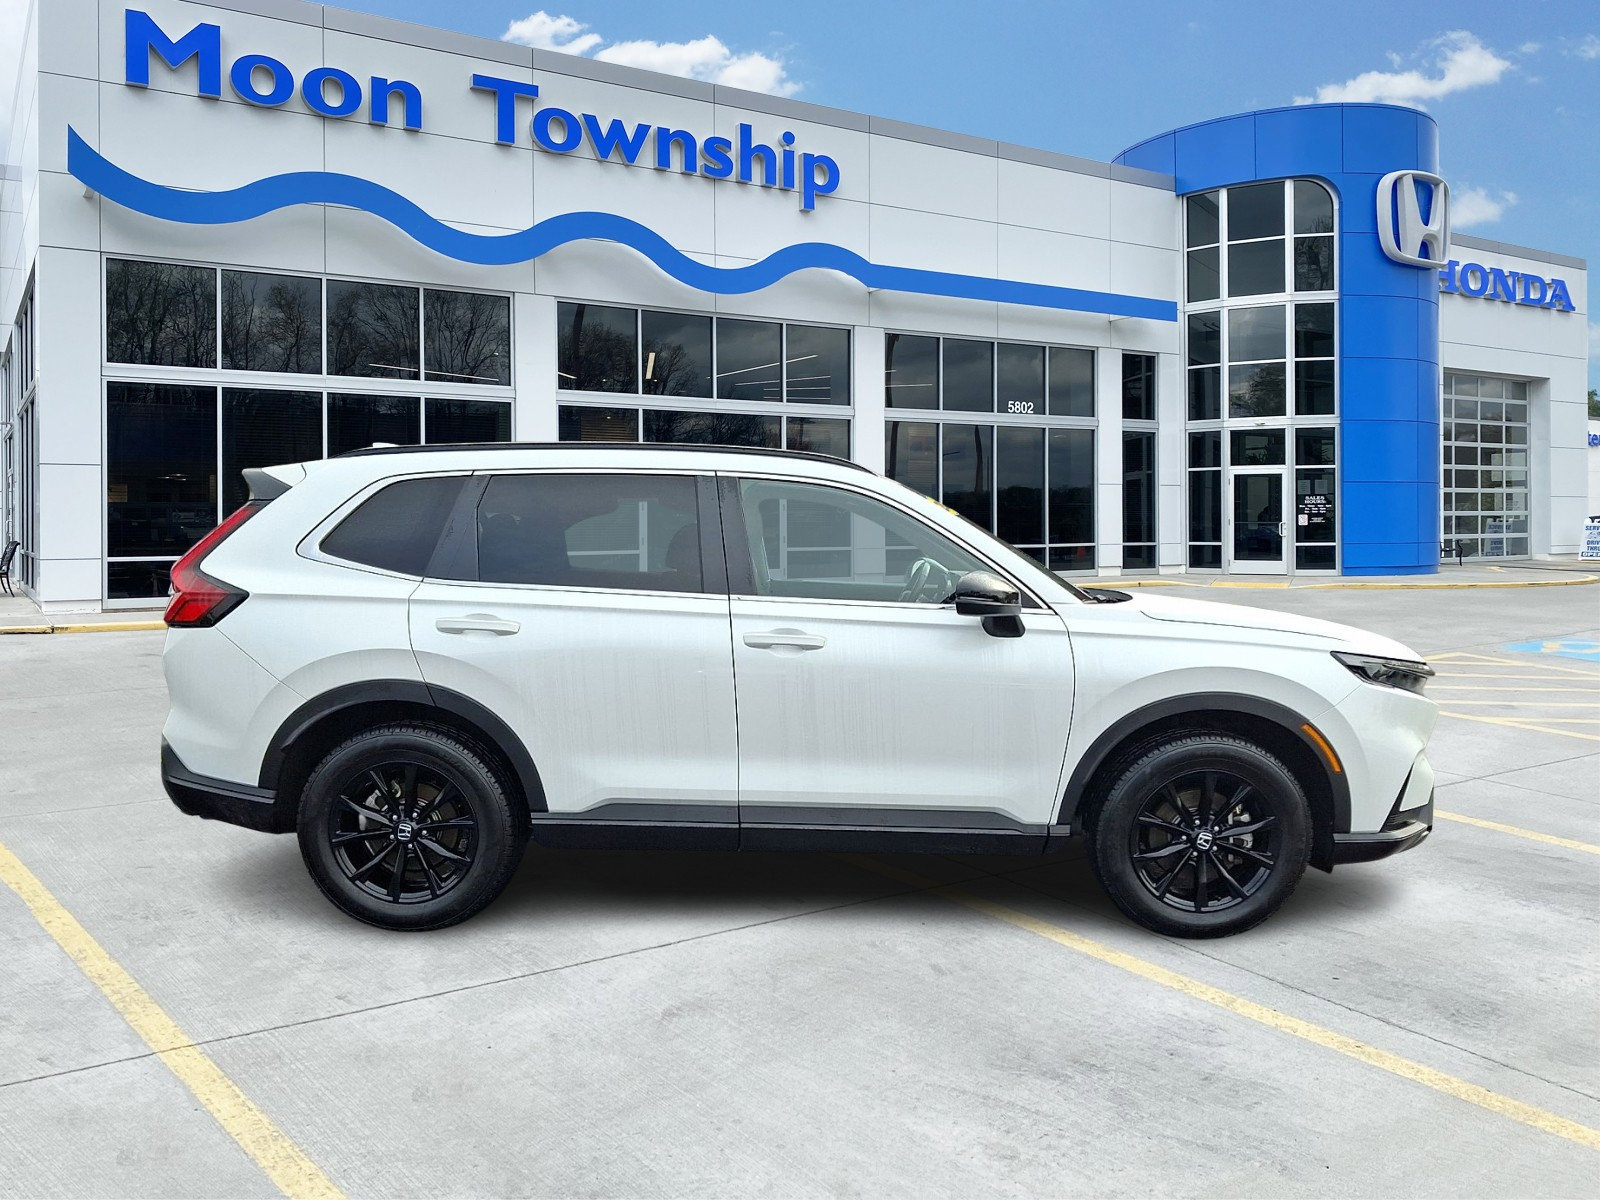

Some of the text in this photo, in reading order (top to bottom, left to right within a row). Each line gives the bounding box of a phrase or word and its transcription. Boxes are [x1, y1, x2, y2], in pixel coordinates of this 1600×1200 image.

[125, 9, 840, 212] Moon Township
[1007, 400, 1034, 414] 5802
